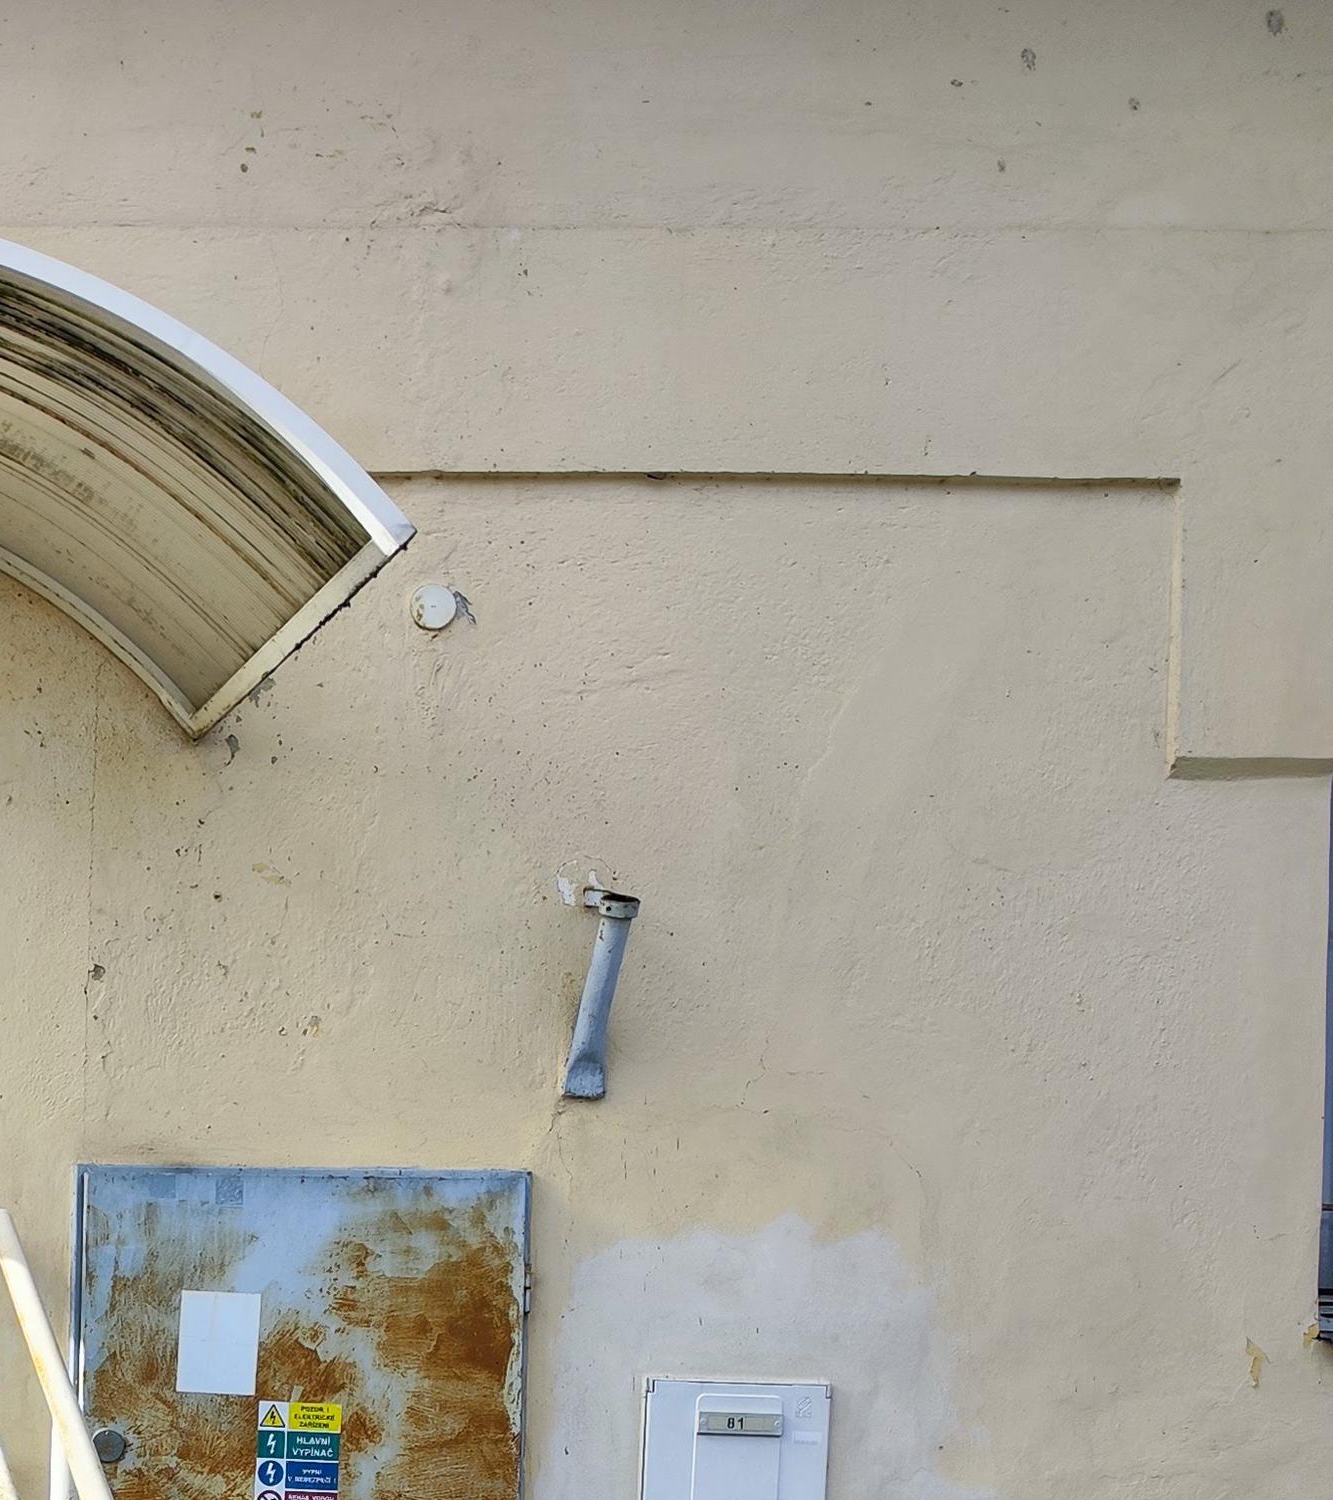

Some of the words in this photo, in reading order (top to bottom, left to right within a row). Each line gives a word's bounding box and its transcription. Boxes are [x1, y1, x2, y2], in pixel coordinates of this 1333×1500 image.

[726, 1417, 744, 1430] 81
[296, 1435, 331, 1446] HLAVNÍ
[292, 1447, 334, 1457] VYPÍNAČ
